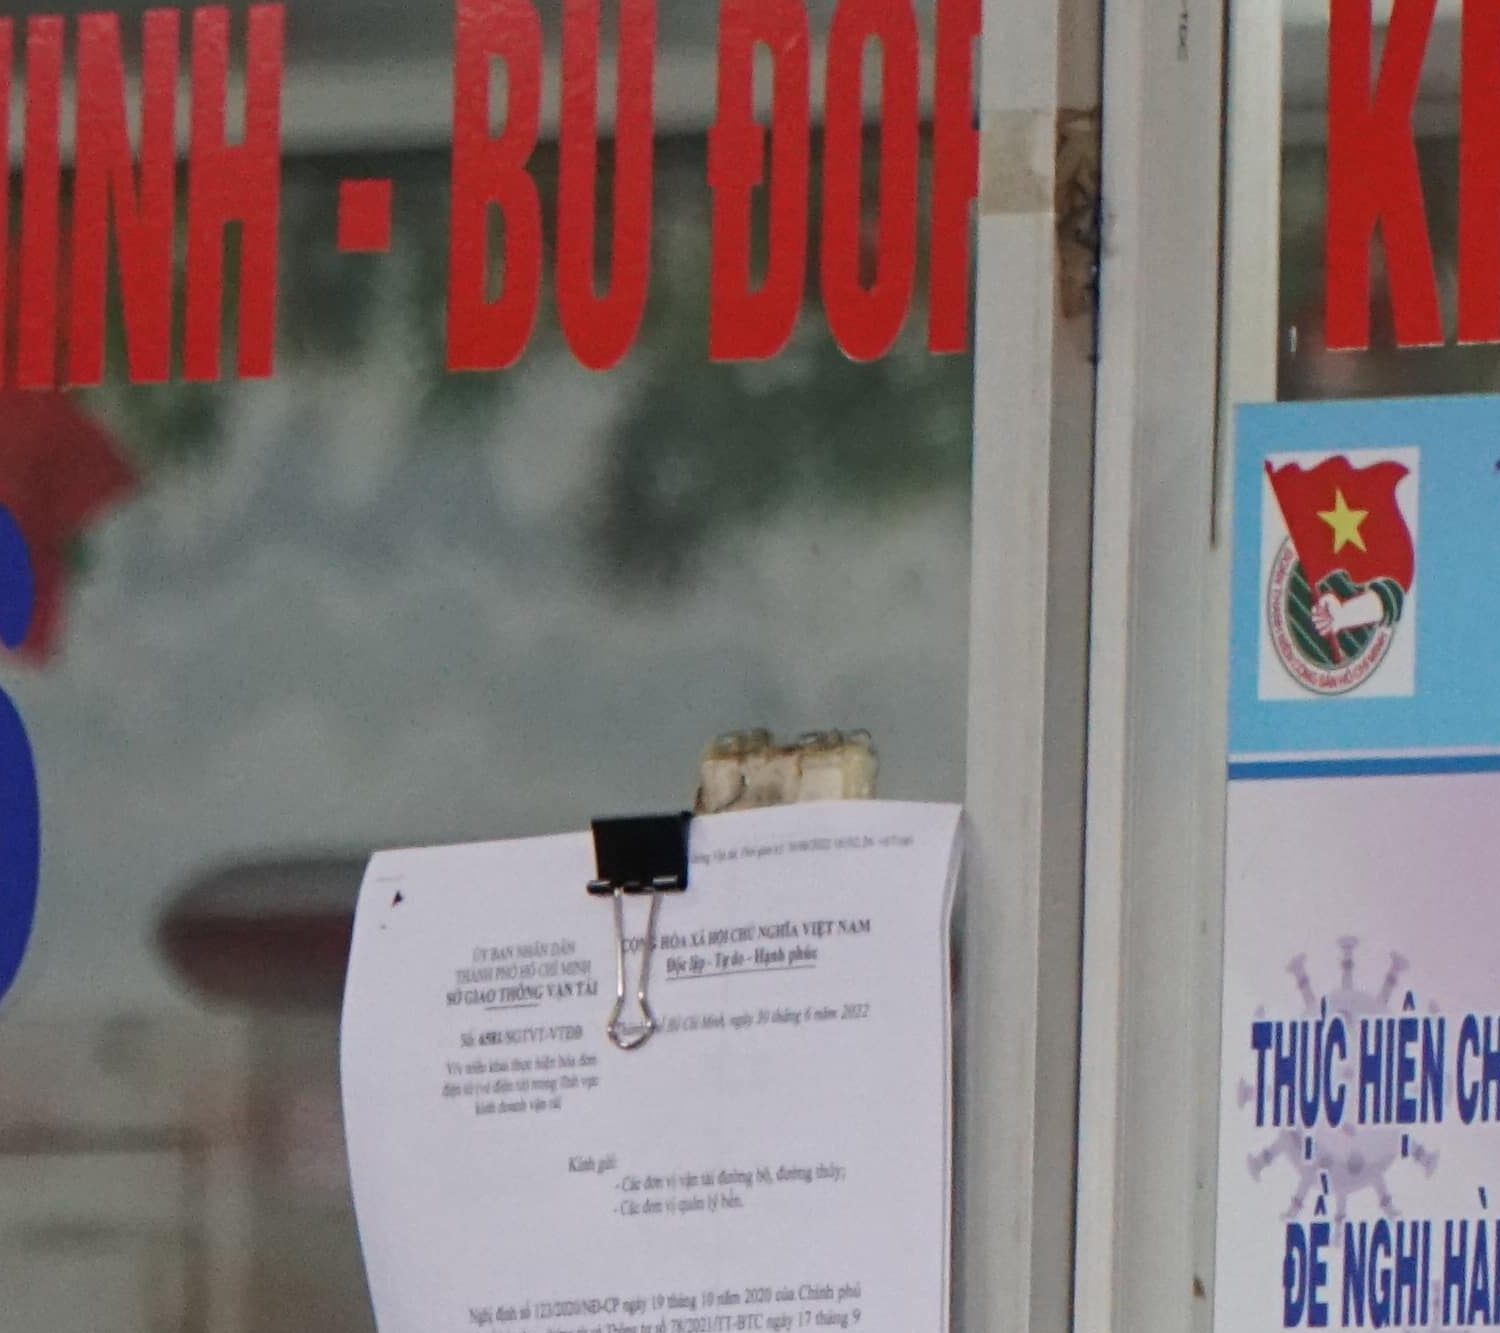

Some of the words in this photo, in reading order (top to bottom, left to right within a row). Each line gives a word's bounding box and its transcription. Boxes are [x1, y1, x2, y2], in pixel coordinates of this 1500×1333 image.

[1251, 996, 1346, 1160] THỰC
[1359, 998, 1446, 1158] HIỆN
[1282, 1172, 1330, 1329] ĐỀ
